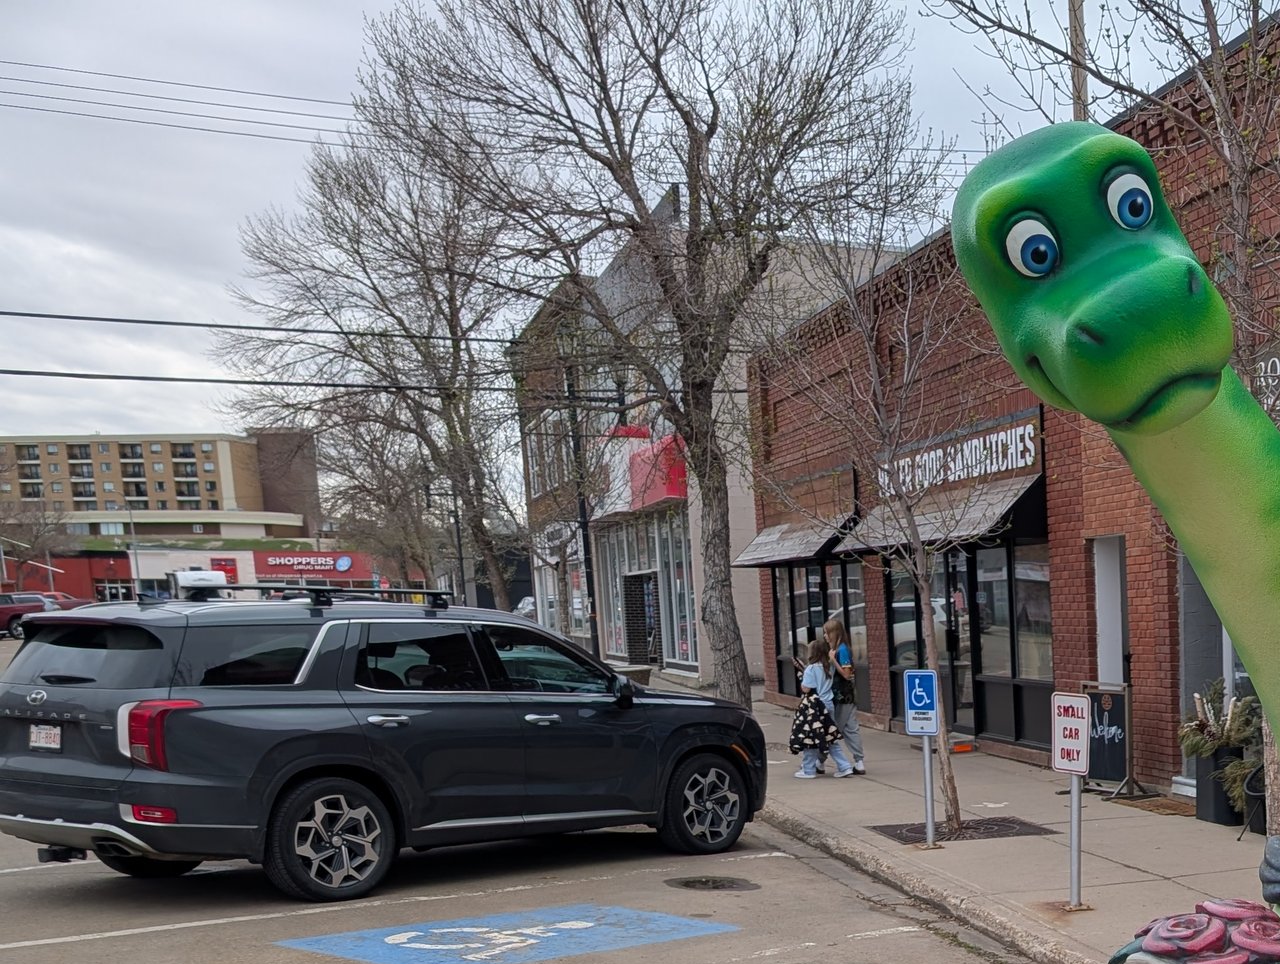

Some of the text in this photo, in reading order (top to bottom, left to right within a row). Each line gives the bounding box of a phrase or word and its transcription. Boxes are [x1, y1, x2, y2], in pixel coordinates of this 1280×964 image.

[915, 448, 944, 490] GOOD
[947, 423, 1035, 482] SANDWICHES
[267, 556, 334, 565] SHOPPERS
[1056, 705, 1085, 719] SMALL
[1062, 726, 1080, 740] CAR
[1060, 748, 1081, 761] ONLY
